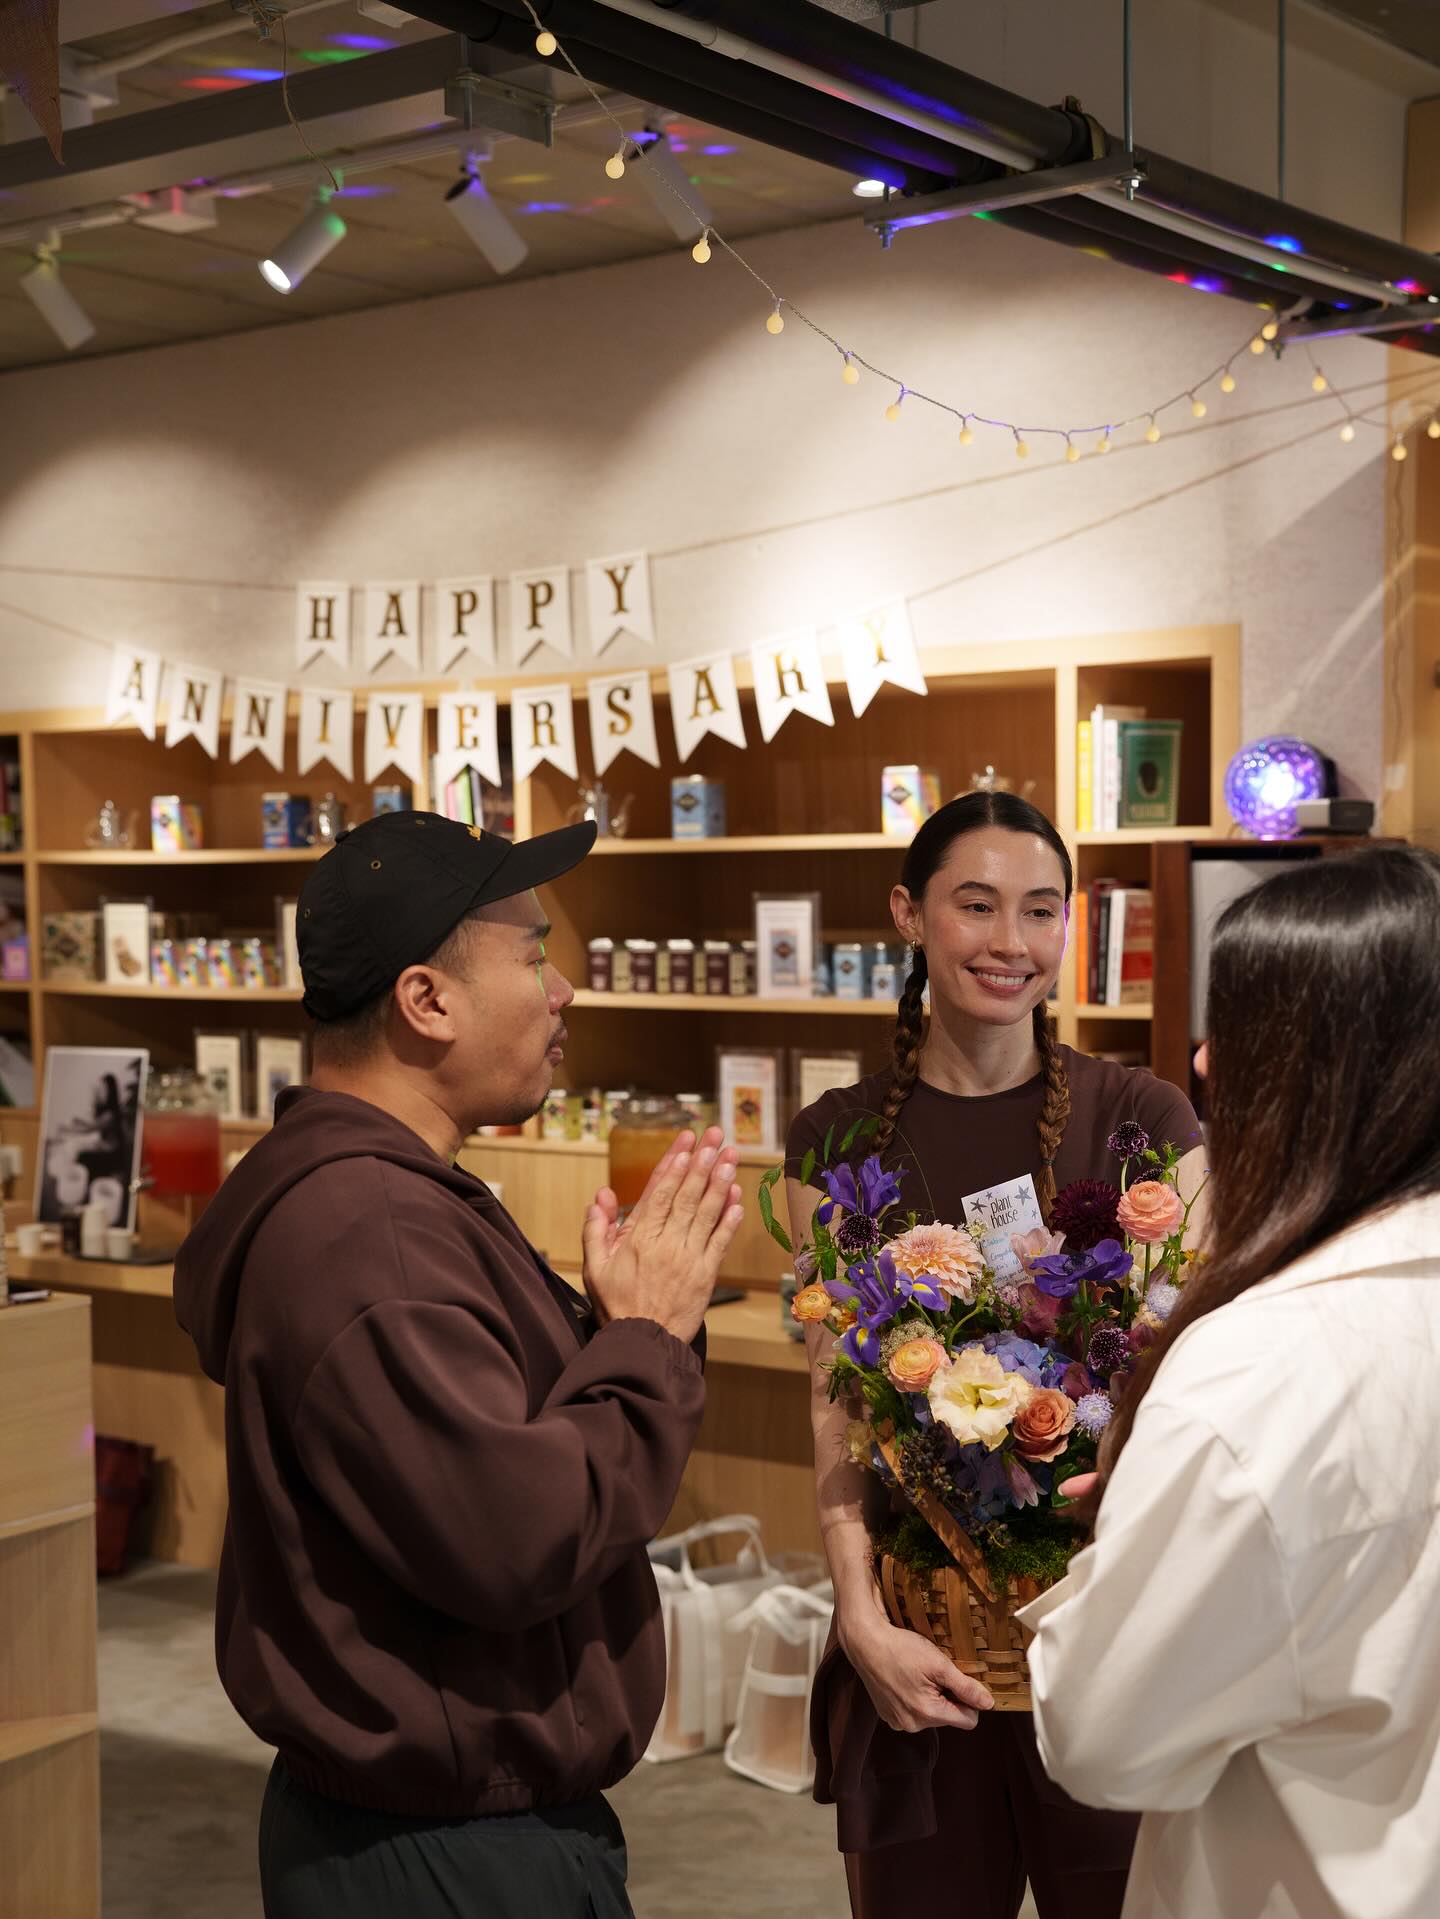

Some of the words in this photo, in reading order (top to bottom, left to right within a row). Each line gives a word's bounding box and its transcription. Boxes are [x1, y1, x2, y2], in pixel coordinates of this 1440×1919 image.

[308, 565, 635, 641] HAPPY
[122, 613, 890, 750] ANNIVERSARY
[990, 1195, 1013, 1215] plant
[990, 1208, 1018, 1229] house
